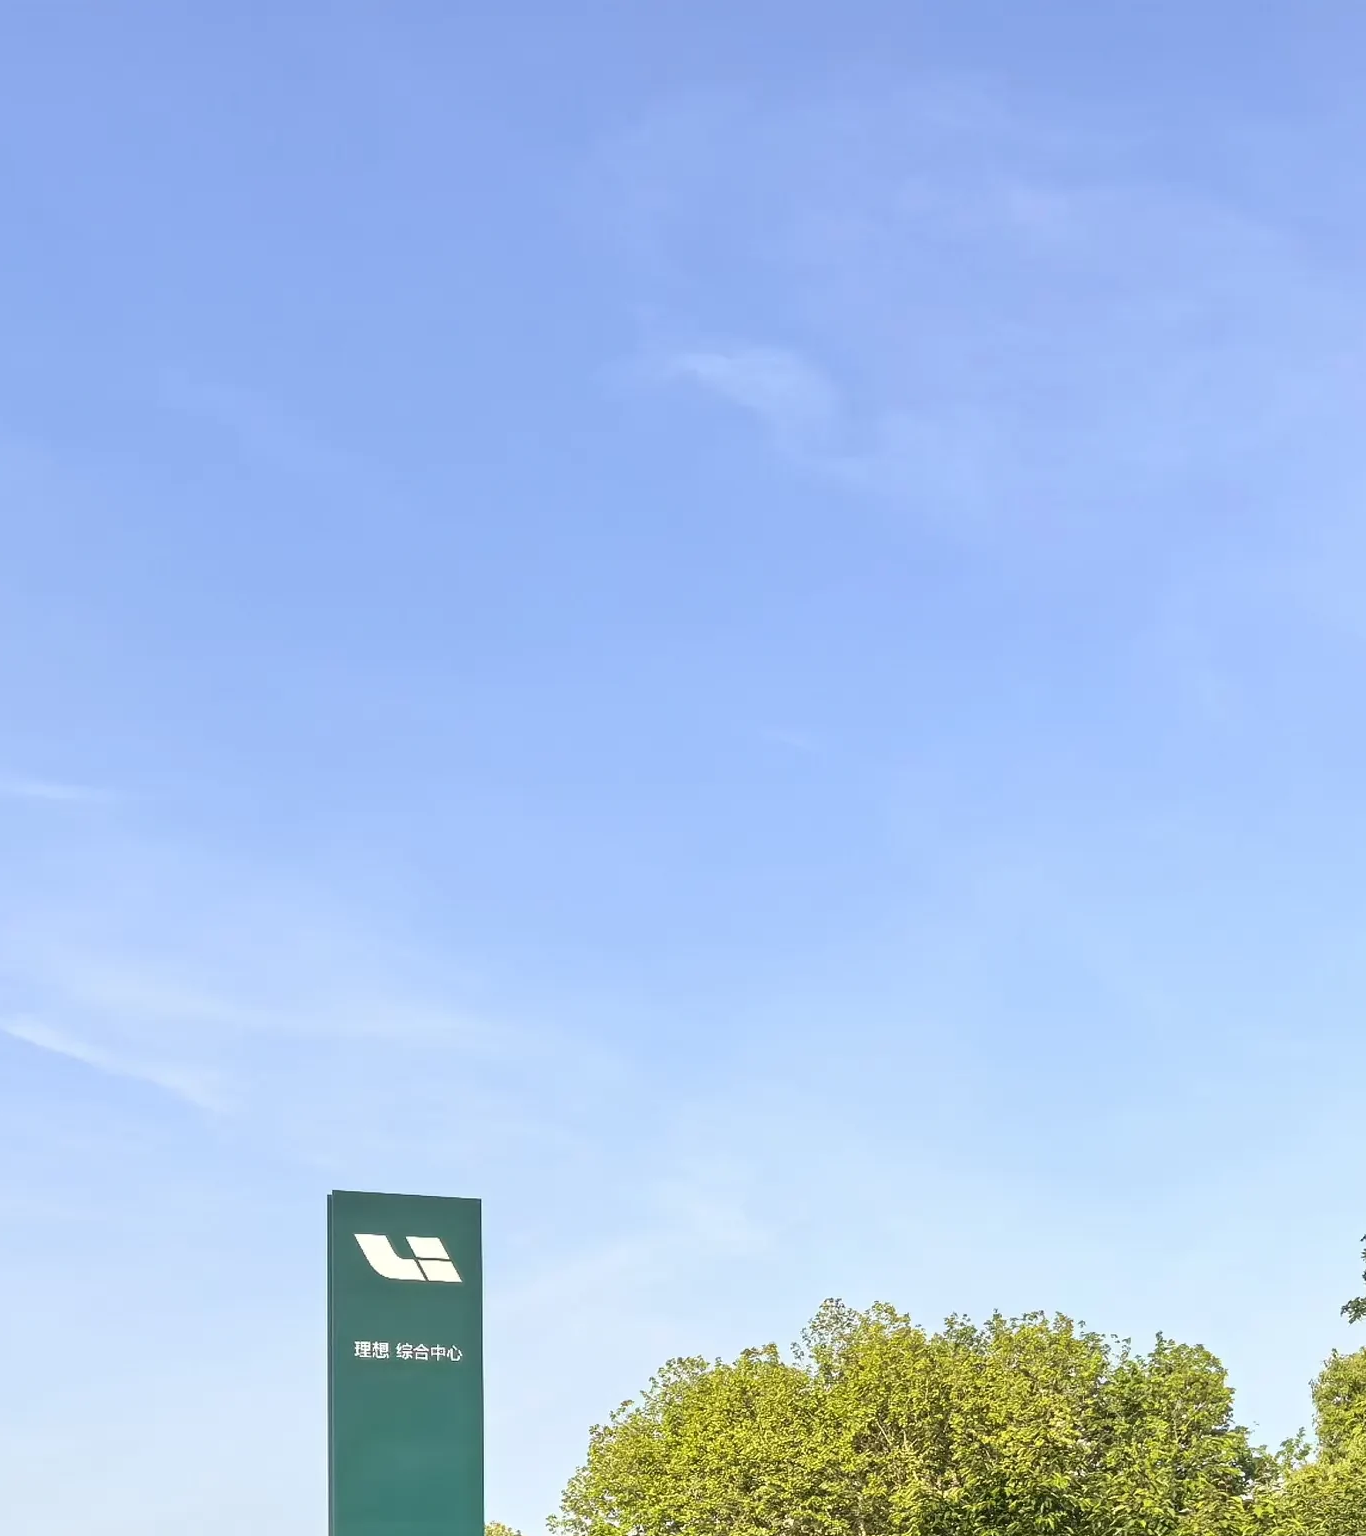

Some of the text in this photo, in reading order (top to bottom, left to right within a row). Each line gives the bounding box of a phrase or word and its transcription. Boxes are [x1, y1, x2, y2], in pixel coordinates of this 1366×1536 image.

[354, 1341, 463, 1361] 理想 综合中心
